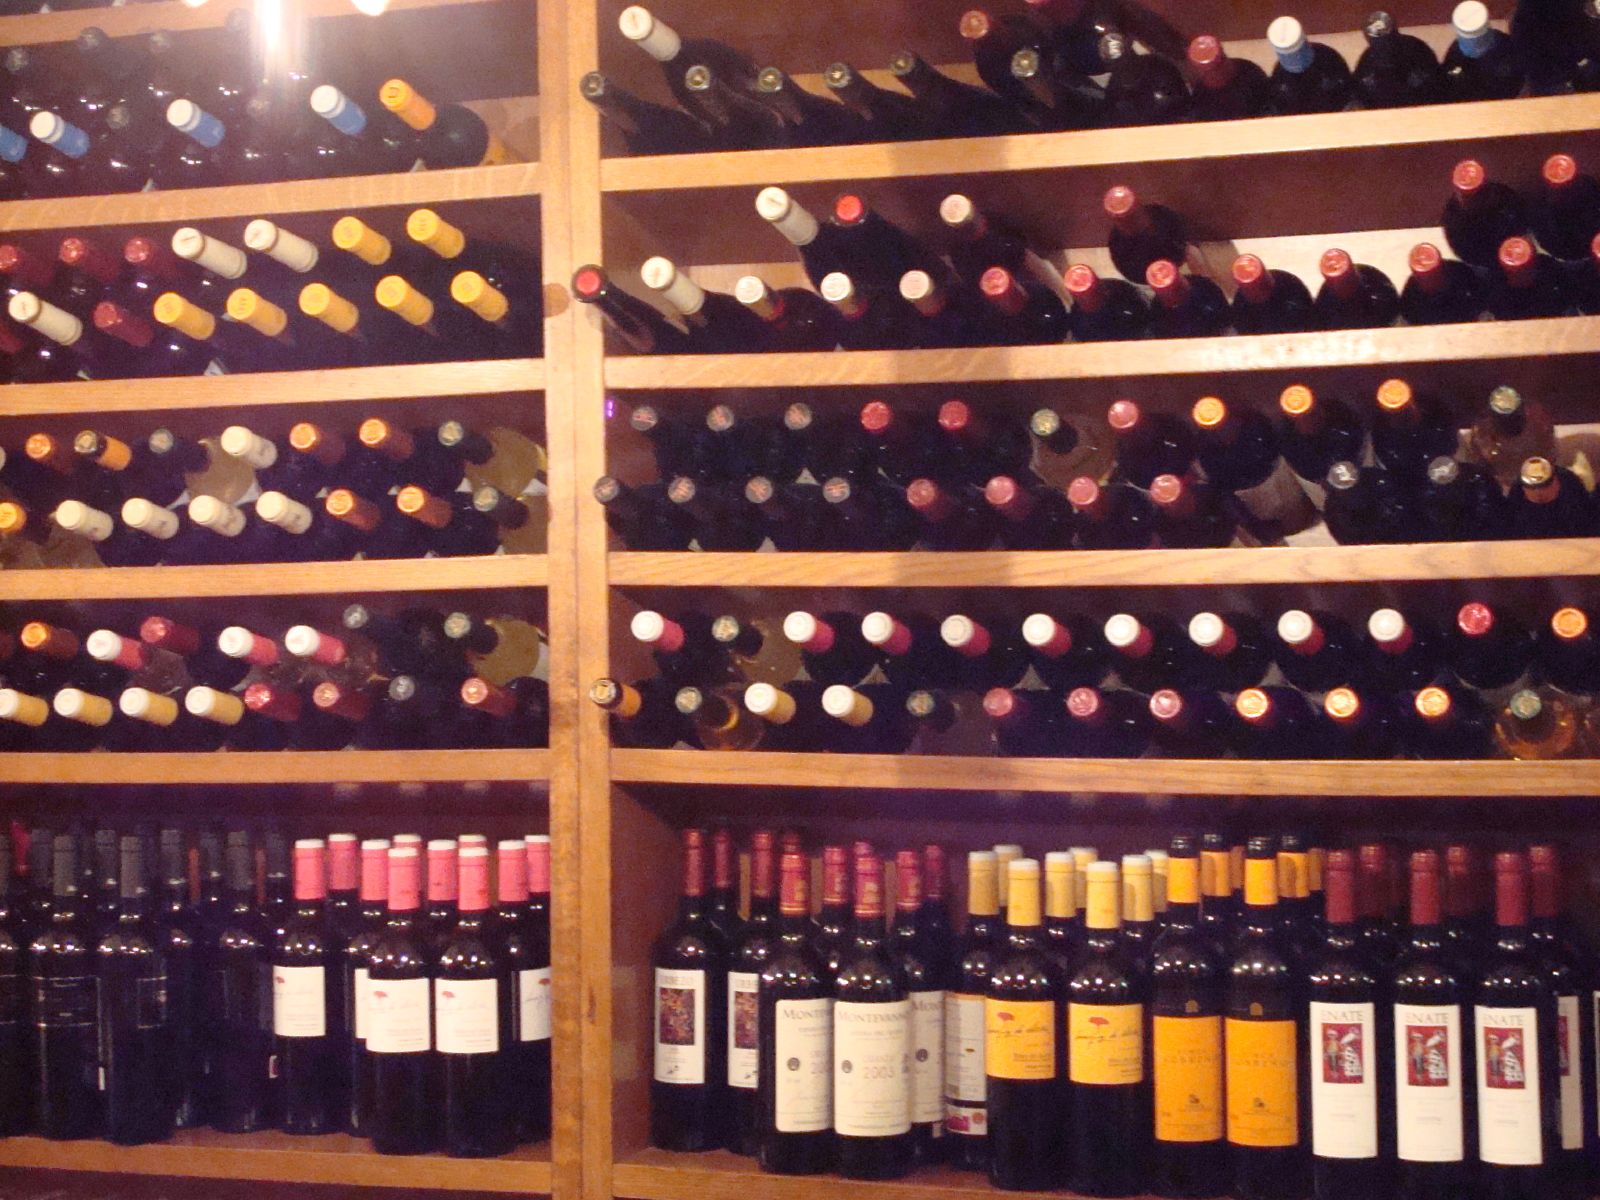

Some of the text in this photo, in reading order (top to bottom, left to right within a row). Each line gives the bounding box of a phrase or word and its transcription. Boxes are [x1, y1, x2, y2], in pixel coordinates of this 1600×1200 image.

[1320, 1010, 1364, 1022] ENATE
[1405, 1012, 1449, 1024] ENATE
[1483, 1014, 1525, 1026] ENATE
